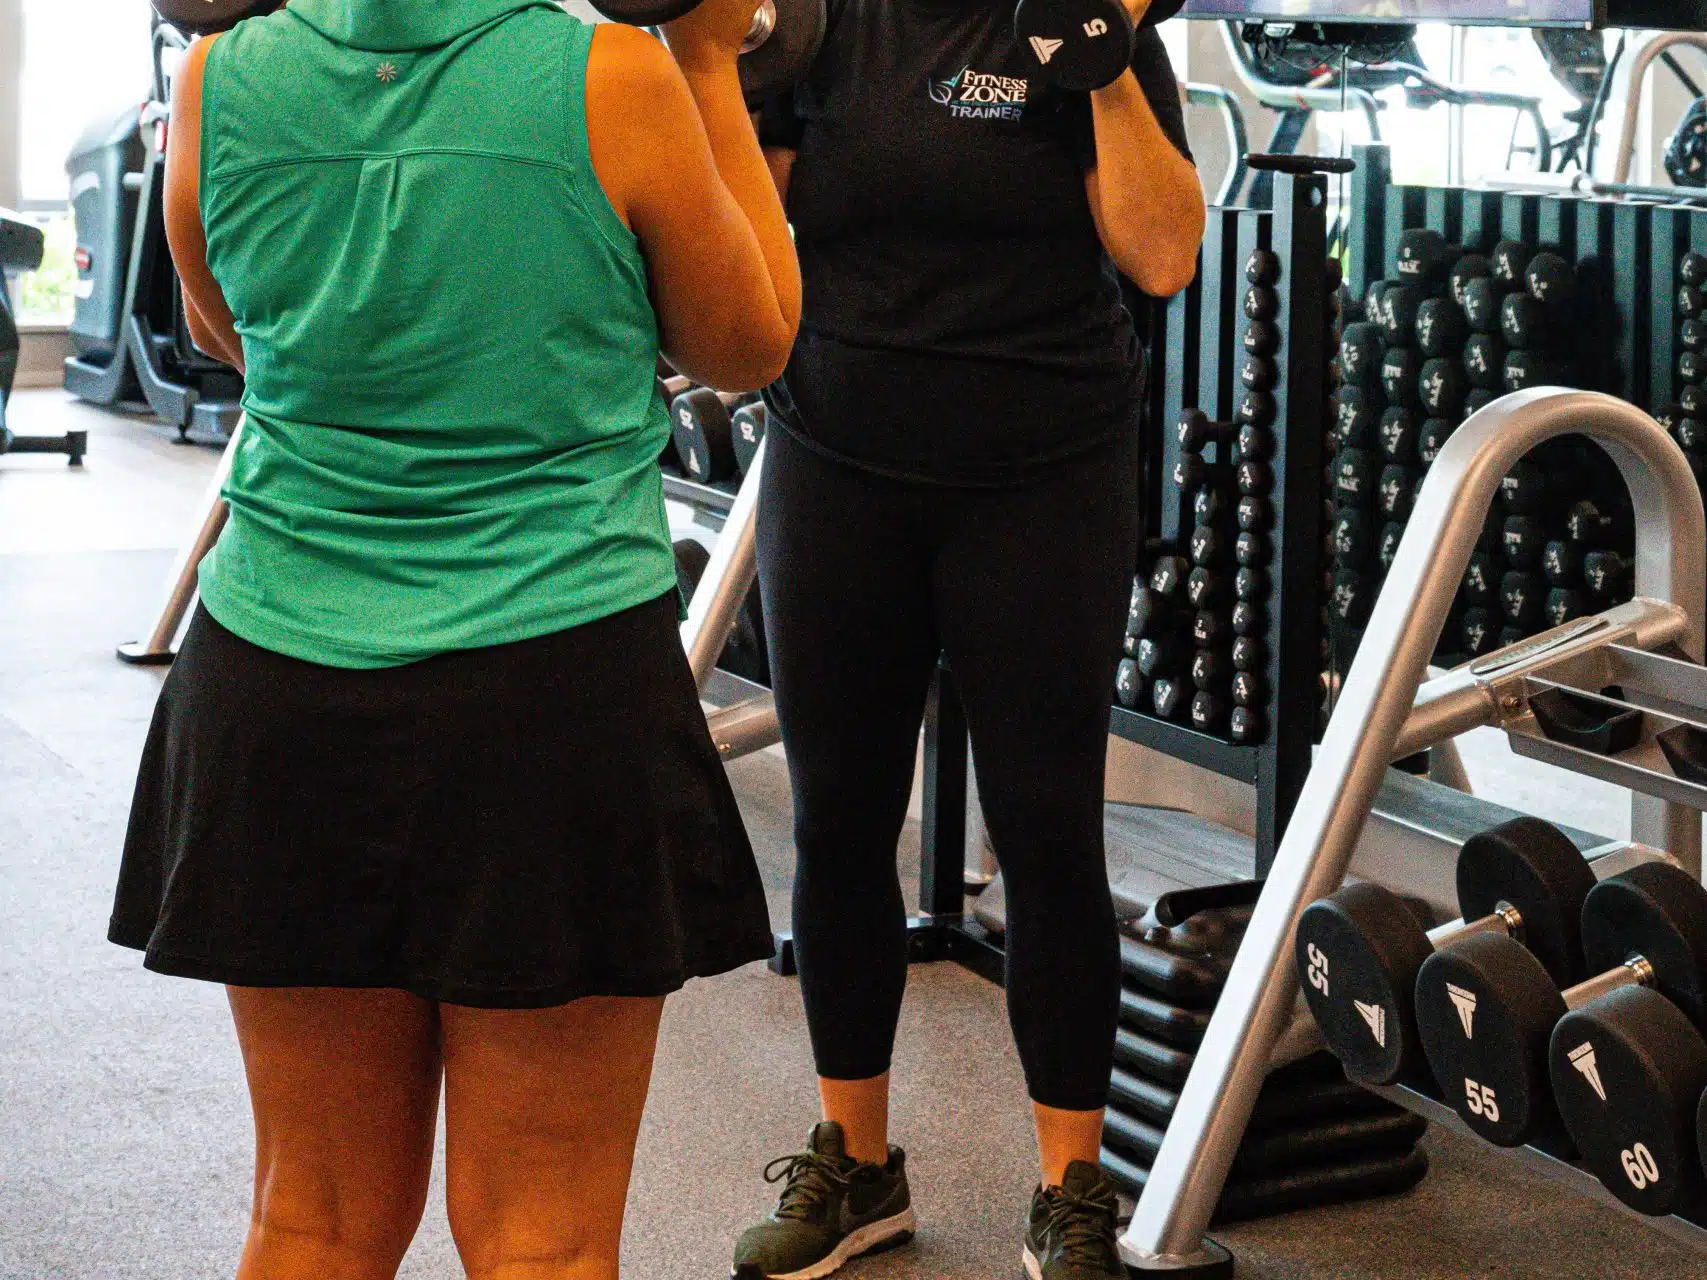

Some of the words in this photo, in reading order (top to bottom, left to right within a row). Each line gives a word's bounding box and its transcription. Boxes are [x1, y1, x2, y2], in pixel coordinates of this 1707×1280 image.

[1083, 18, 1108, 38] 5
[963, 70, 1028, 89] FITNESS
[960, 84, 1027, 103] ZONE
[950, 104, 1022, 121] TRAINER
[1307, 943, 1329, 997] 55
[1464, 1077, 1500, 1123] 55
[1621, 1142, 1659, 1190] 60
